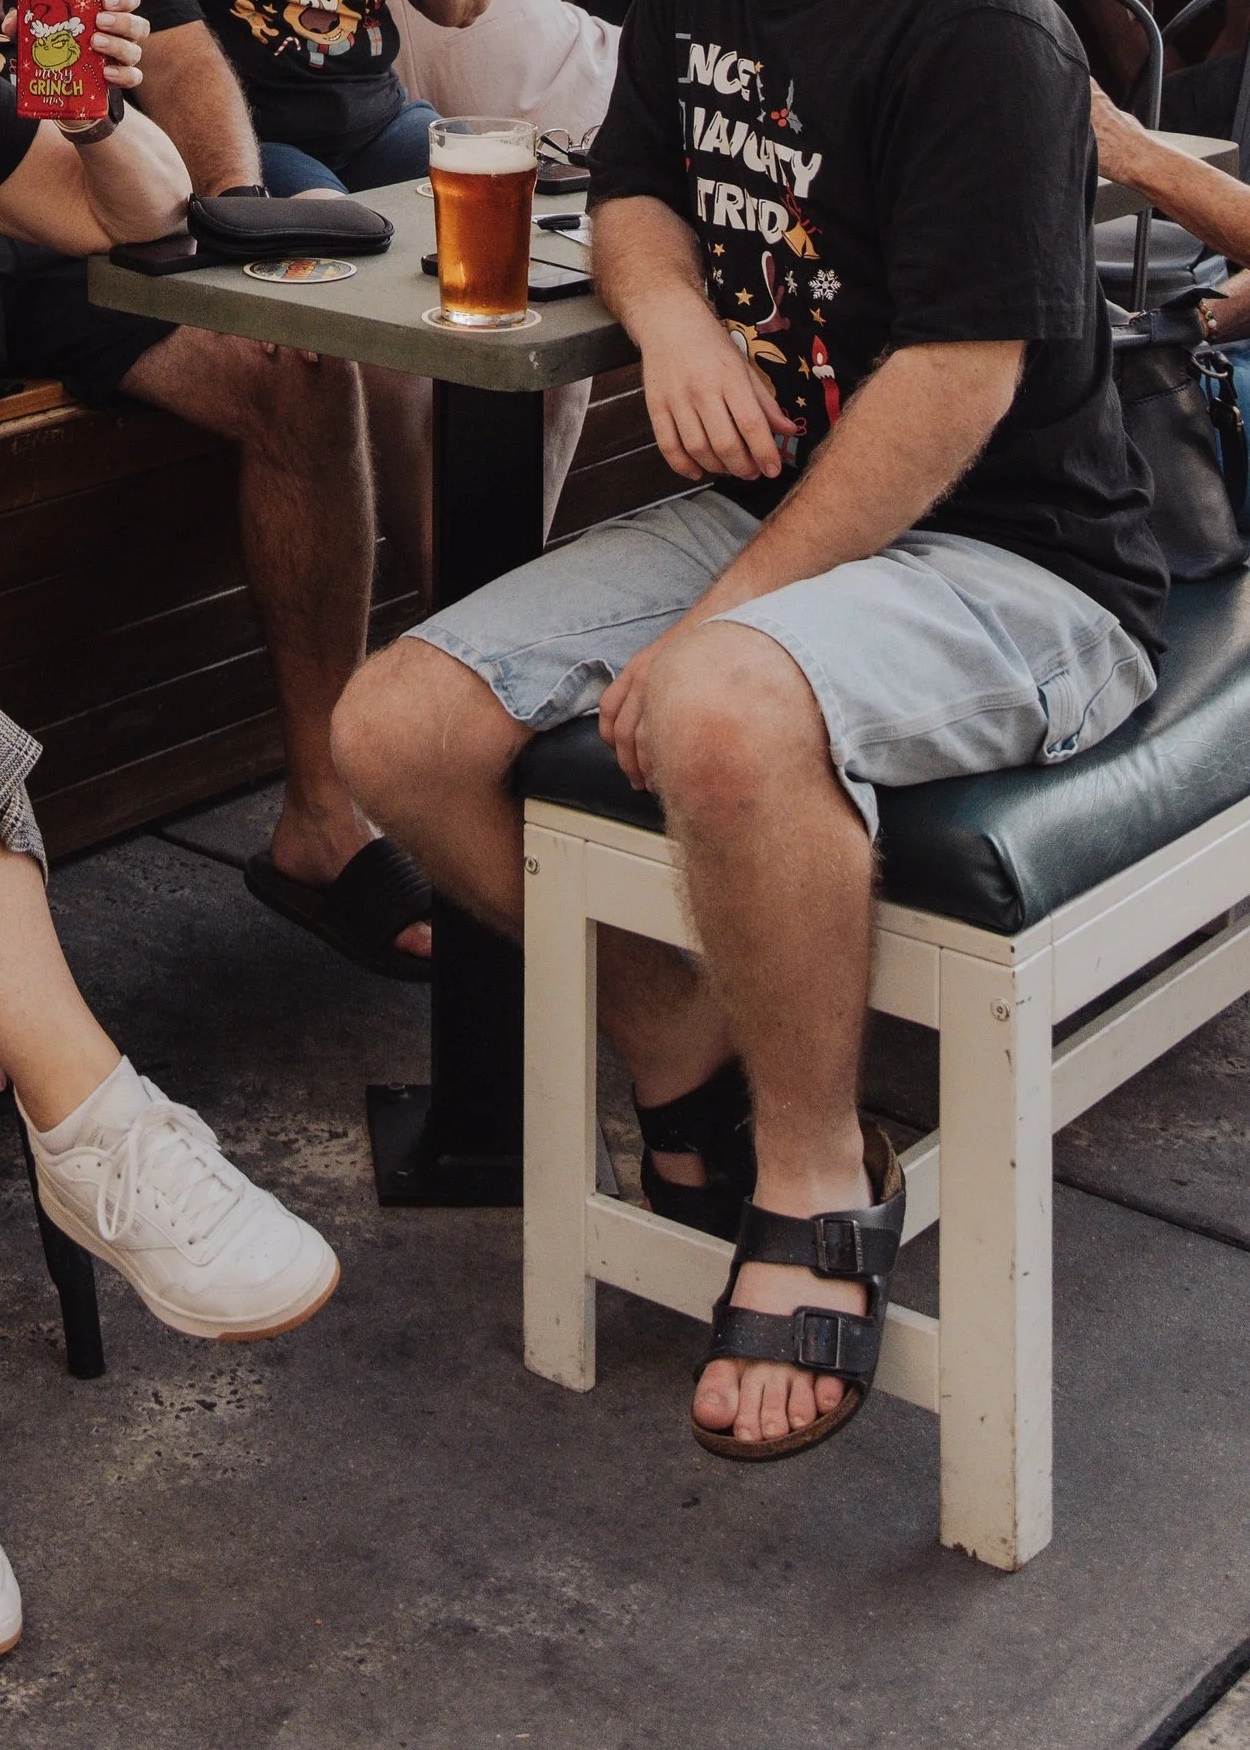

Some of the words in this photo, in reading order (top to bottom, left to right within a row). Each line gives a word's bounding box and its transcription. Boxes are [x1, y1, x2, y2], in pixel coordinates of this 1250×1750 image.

[35, 68, 75, 84] merry
[29, 79, 84, 96] GRINCH
[43, 96, 64, 107] mas
